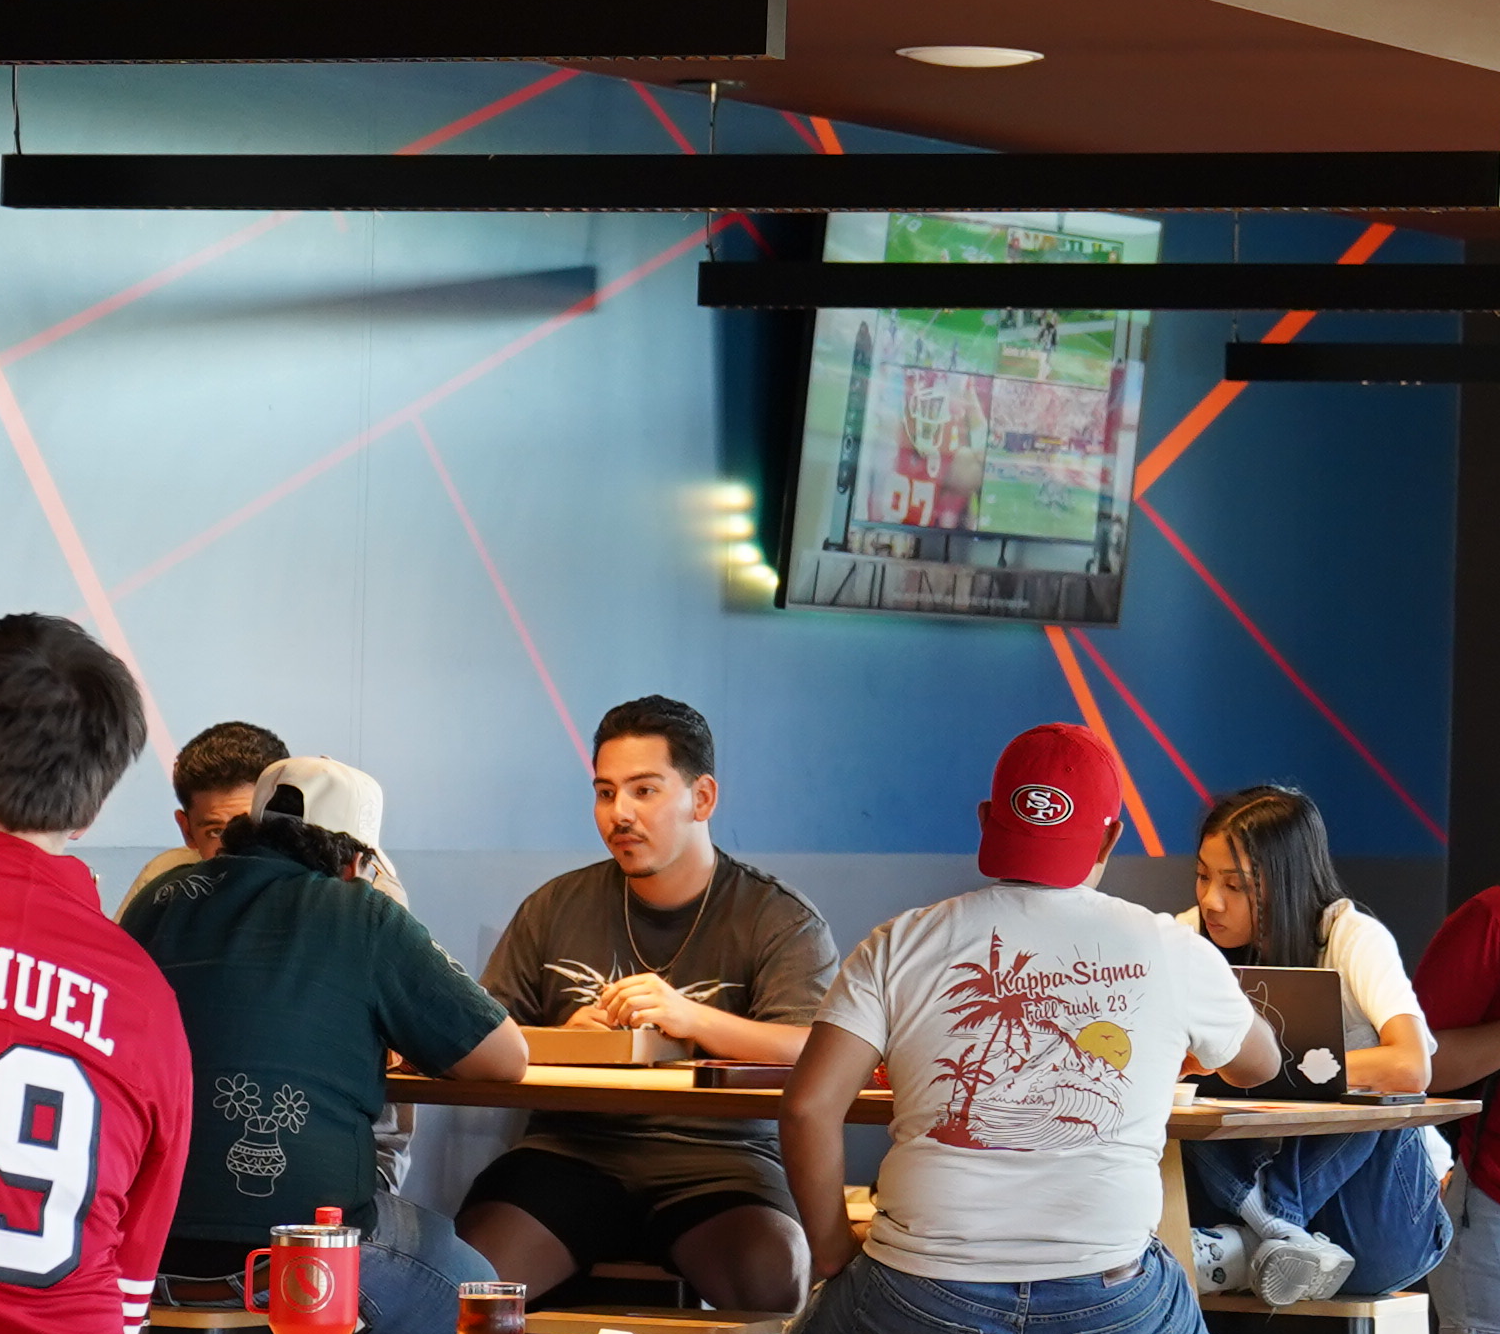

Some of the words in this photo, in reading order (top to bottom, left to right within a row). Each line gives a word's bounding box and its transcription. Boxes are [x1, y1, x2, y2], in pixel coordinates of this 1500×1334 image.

[1026, 790, 1062, 820] SF
[994, 970, 1067, 998] Kappa
[1072, 961, 1147, 988] Sigma
[1023, 1001, 1058, 1021] Fall
[1063, 996, 1100, 1017] rush
[1107, 994, 1128, 1012] 23
